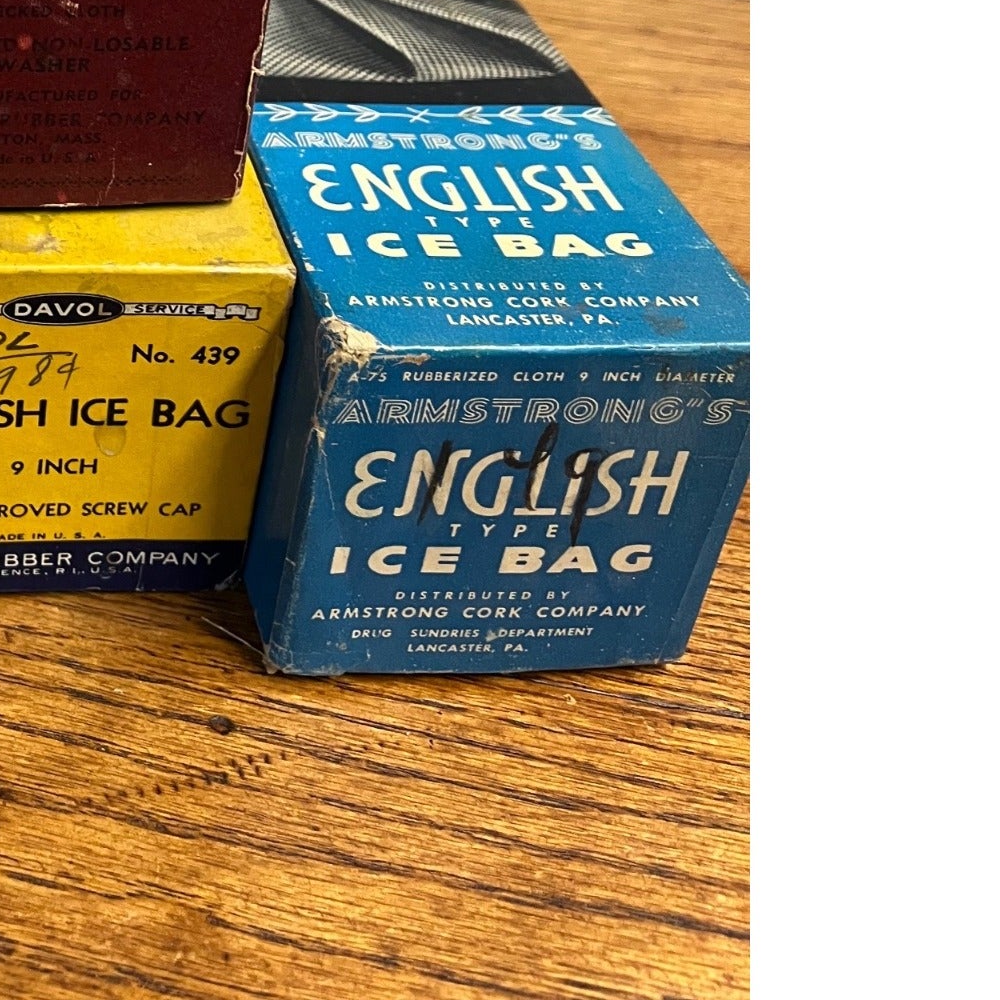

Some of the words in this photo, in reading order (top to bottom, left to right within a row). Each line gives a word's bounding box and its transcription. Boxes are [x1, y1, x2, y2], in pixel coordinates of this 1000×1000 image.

[110, 89, 142, 103] FOR
[55, 131, 107, 145] MASS.
[302, 163, 625, 213] ENGLISH
[425, 216, 534, 229] TYPE
[326, 232, 464, 257] ICE
[498, 232, 654, 258] BAG
[423, 280, 566, 291] DISTRIBUTED
[581, 280, 604, 291] BY
[348, 295, 494, 308] ARMSTRONG
[506, 295, 569, 308] CORK
[584, 295, 701, 308] COMPANY
[14, 301, 113, 319] DAVOL
[133, 303, 206, 316] SERVICE
[446, 313, 574, 328] LANCASTER,
[583, 313, 621, 326] PA.
[130, 342, 176, 365] No.
[190, 346, 241, 366] 439
[402, 371, 499, 383] RUBBERIZED
[512, 371, 565, 383] CLOTH
[579, 371, 589, 383] 9
[602, 371, 642, 382] INCH
[69, 397, 129, 427] ICE
[151, 398, 251, 430] BAG
[10, 459, 23, 476] 9
[37, 458, 99, 475] INCH
[344, 448, 691, 518] ENGLISH
[82, 501, 149, 517] SCREW
[158, 501, 202, 517] CAP
[31, 532, 47, 541] IN
[449, 523, 560, 539] TYPE
[87, 550, 221, 567] COMPANY
[329, 546, 462, 576] ICE
[498, 544, 655, 575] BAG
[395, 590, 534, 601] DISTRIBUTED
[547, 590, 572, 600] BY
[310, 606, 450, 621] ARMSTRONG
[462, 605, 523, 619] CORK
[536, 604, 647, 619] COMPANY
[351, 627, 393, 639] DRUG
[409, 627, 481, 639] SUNDRIES
[497, 626, 595, 638] DEPARTMENT
[406, 642, 497, 655] LANCASTER,
[503, 642, 529, 653] PA.
